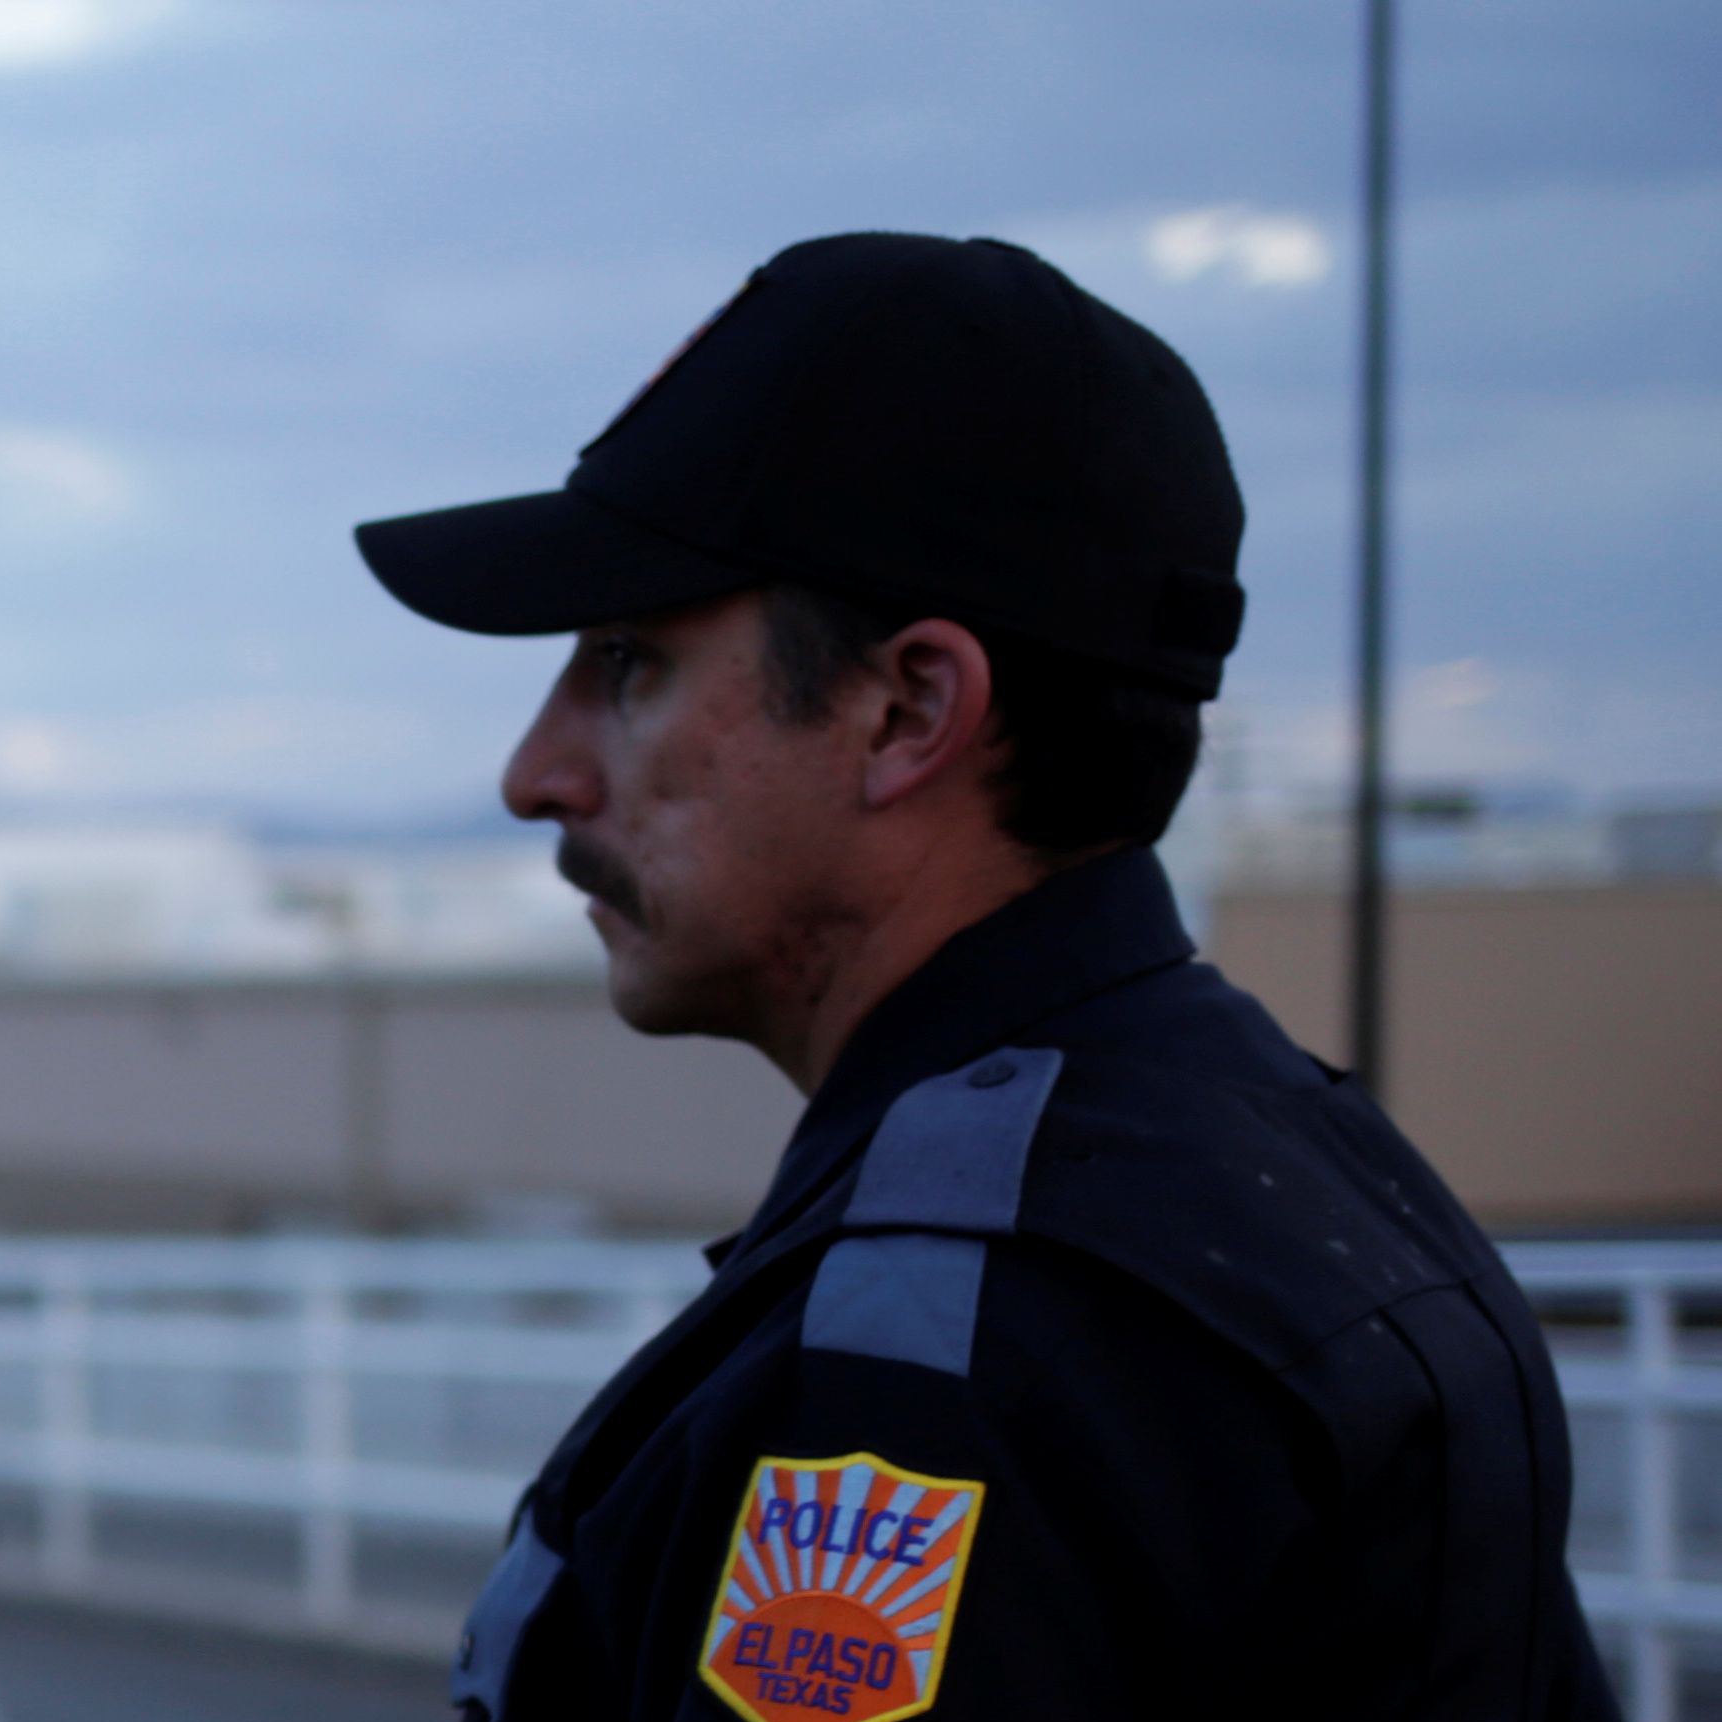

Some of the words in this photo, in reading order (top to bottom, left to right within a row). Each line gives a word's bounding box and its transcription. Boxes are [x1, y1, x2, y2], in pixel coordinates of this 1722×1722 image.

[757, 1498, 934, 1567] POLICE
[733, 1621, 781, 1669] EL
[783, 1627, 899, 1692] PASO
[755, 1671, 855, 1715] TEXAS
